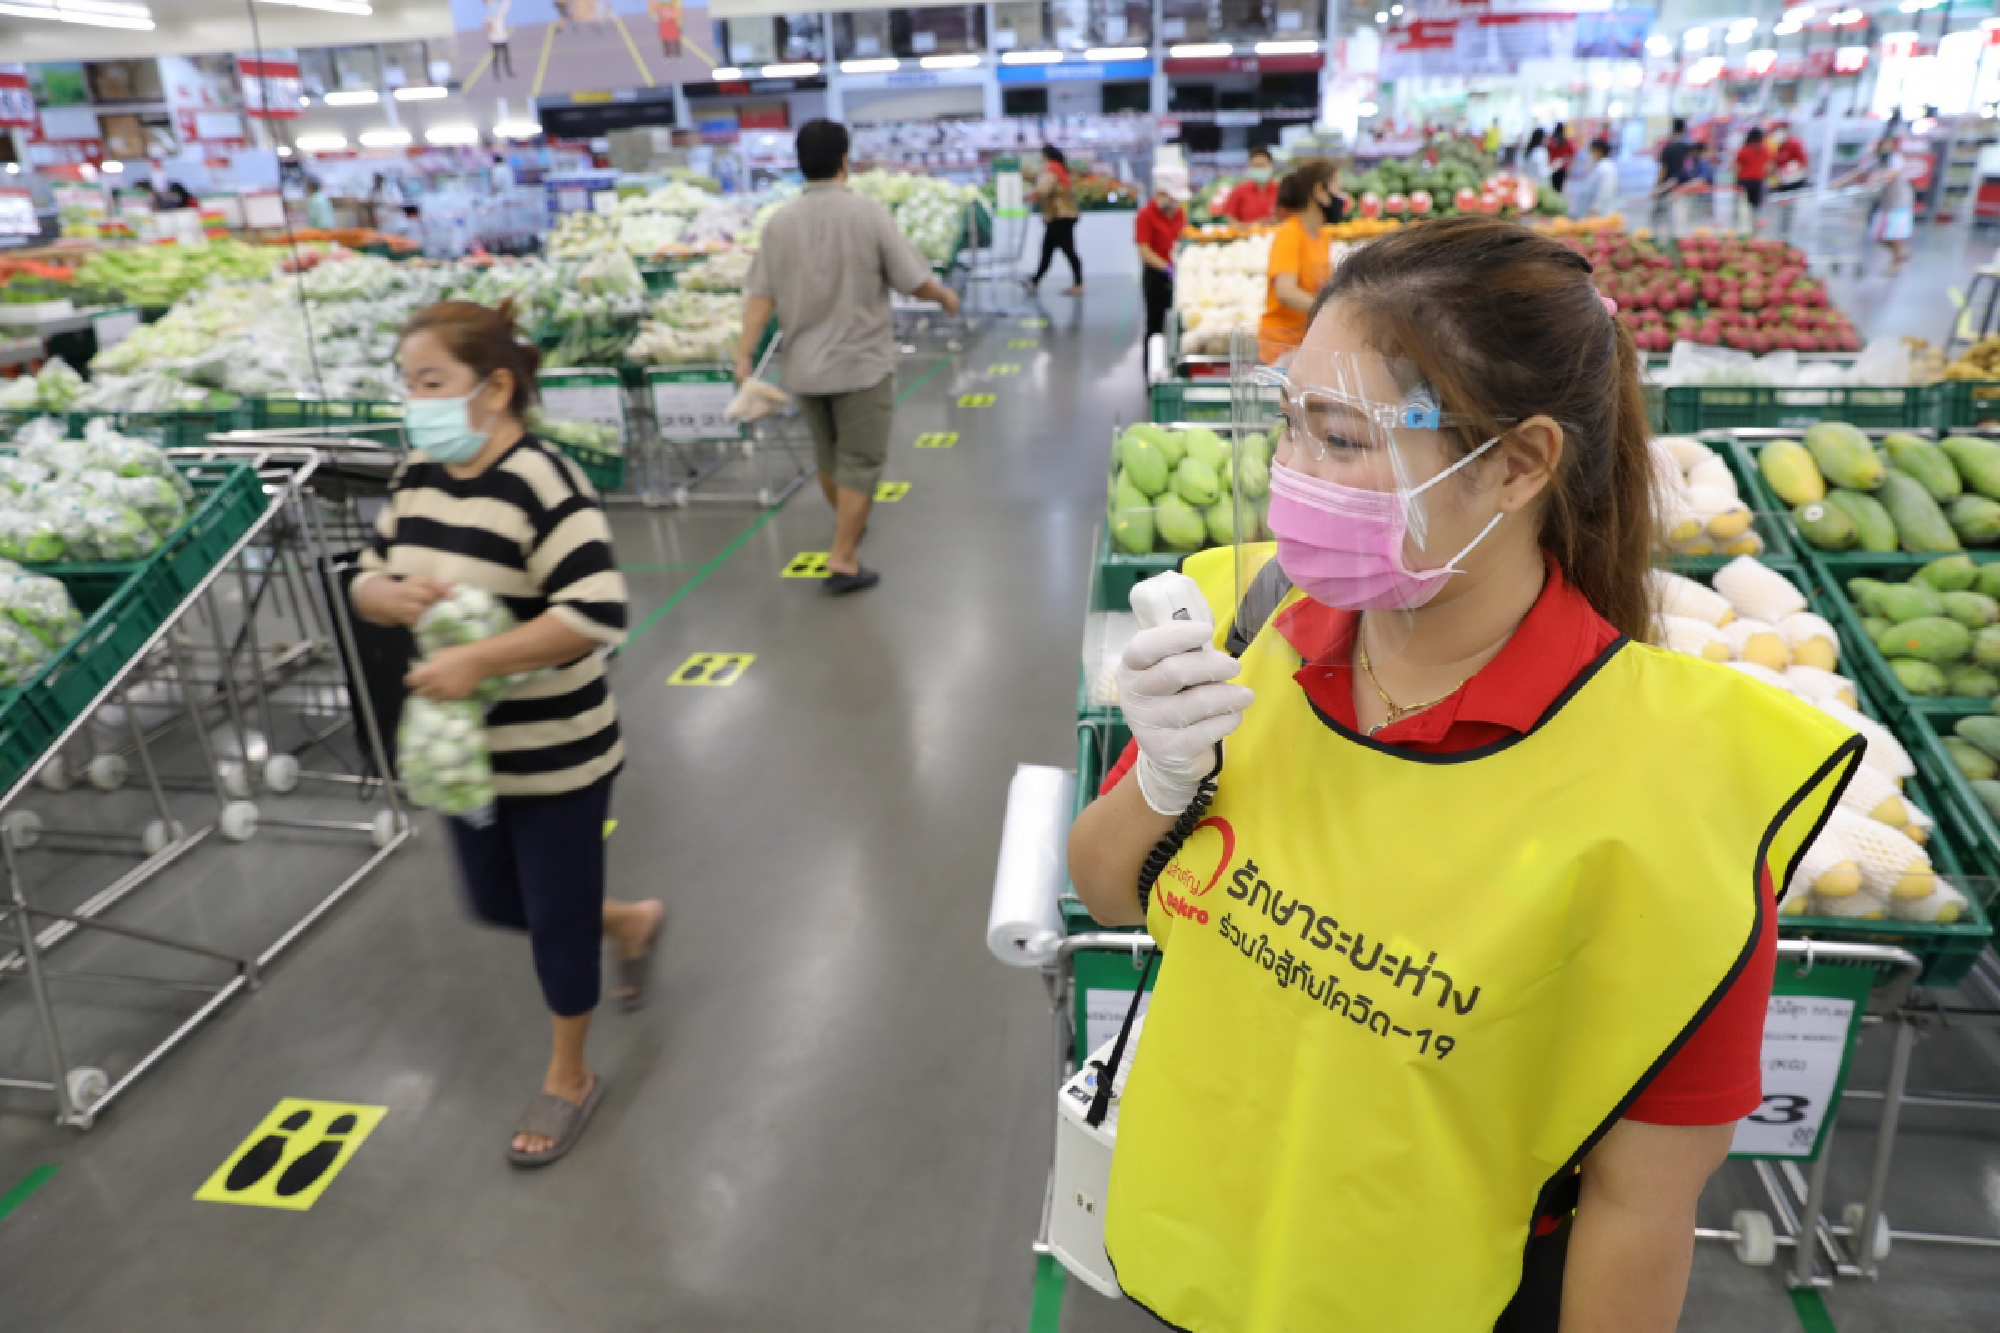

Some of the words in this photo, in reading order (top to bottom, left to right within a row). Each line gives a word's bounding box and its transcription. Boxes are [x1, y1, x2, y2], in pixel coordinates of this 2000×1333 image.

[1226, 858, 1481, 1015] รักษาระยะห่าง
